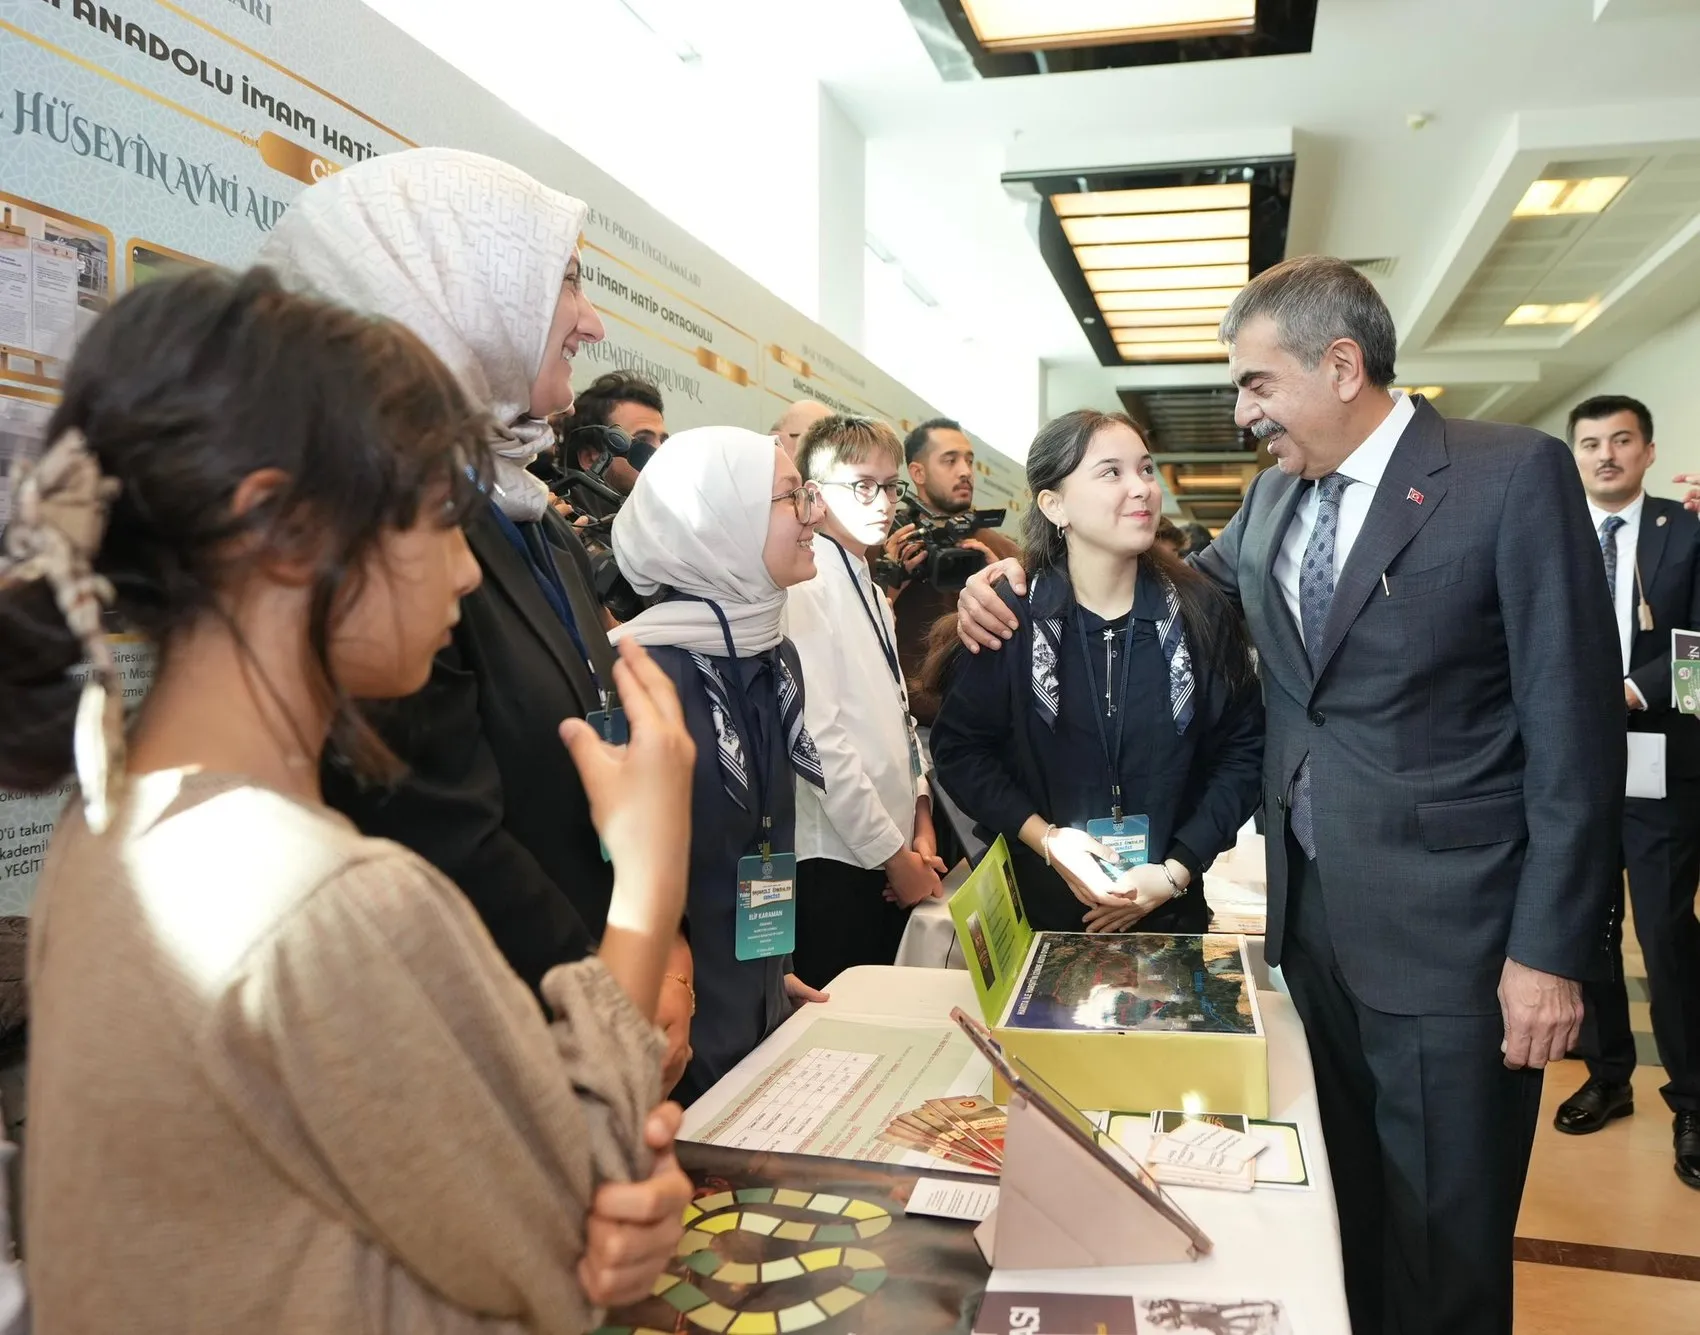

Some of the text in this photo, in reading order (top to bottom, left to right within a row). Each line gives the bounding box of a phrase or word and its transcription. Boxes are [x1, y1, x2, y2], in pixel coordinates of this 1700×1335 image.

[73, 0, 380, 162] ANADOLU İMAM HATİ
[12, 88, 176, 195] HÜSEYİN
[174, 156, 239, 218] AVNİ
[598, 212, 611, 233] VE
[612, 221, 641, 250] PROJE
[596, 267, 628, 300] İMAM
[630, 289, 659, 314] HATİP
[660, 307, 713, 343] ORTAOKULU
[20, 822, 54, 837] takım
